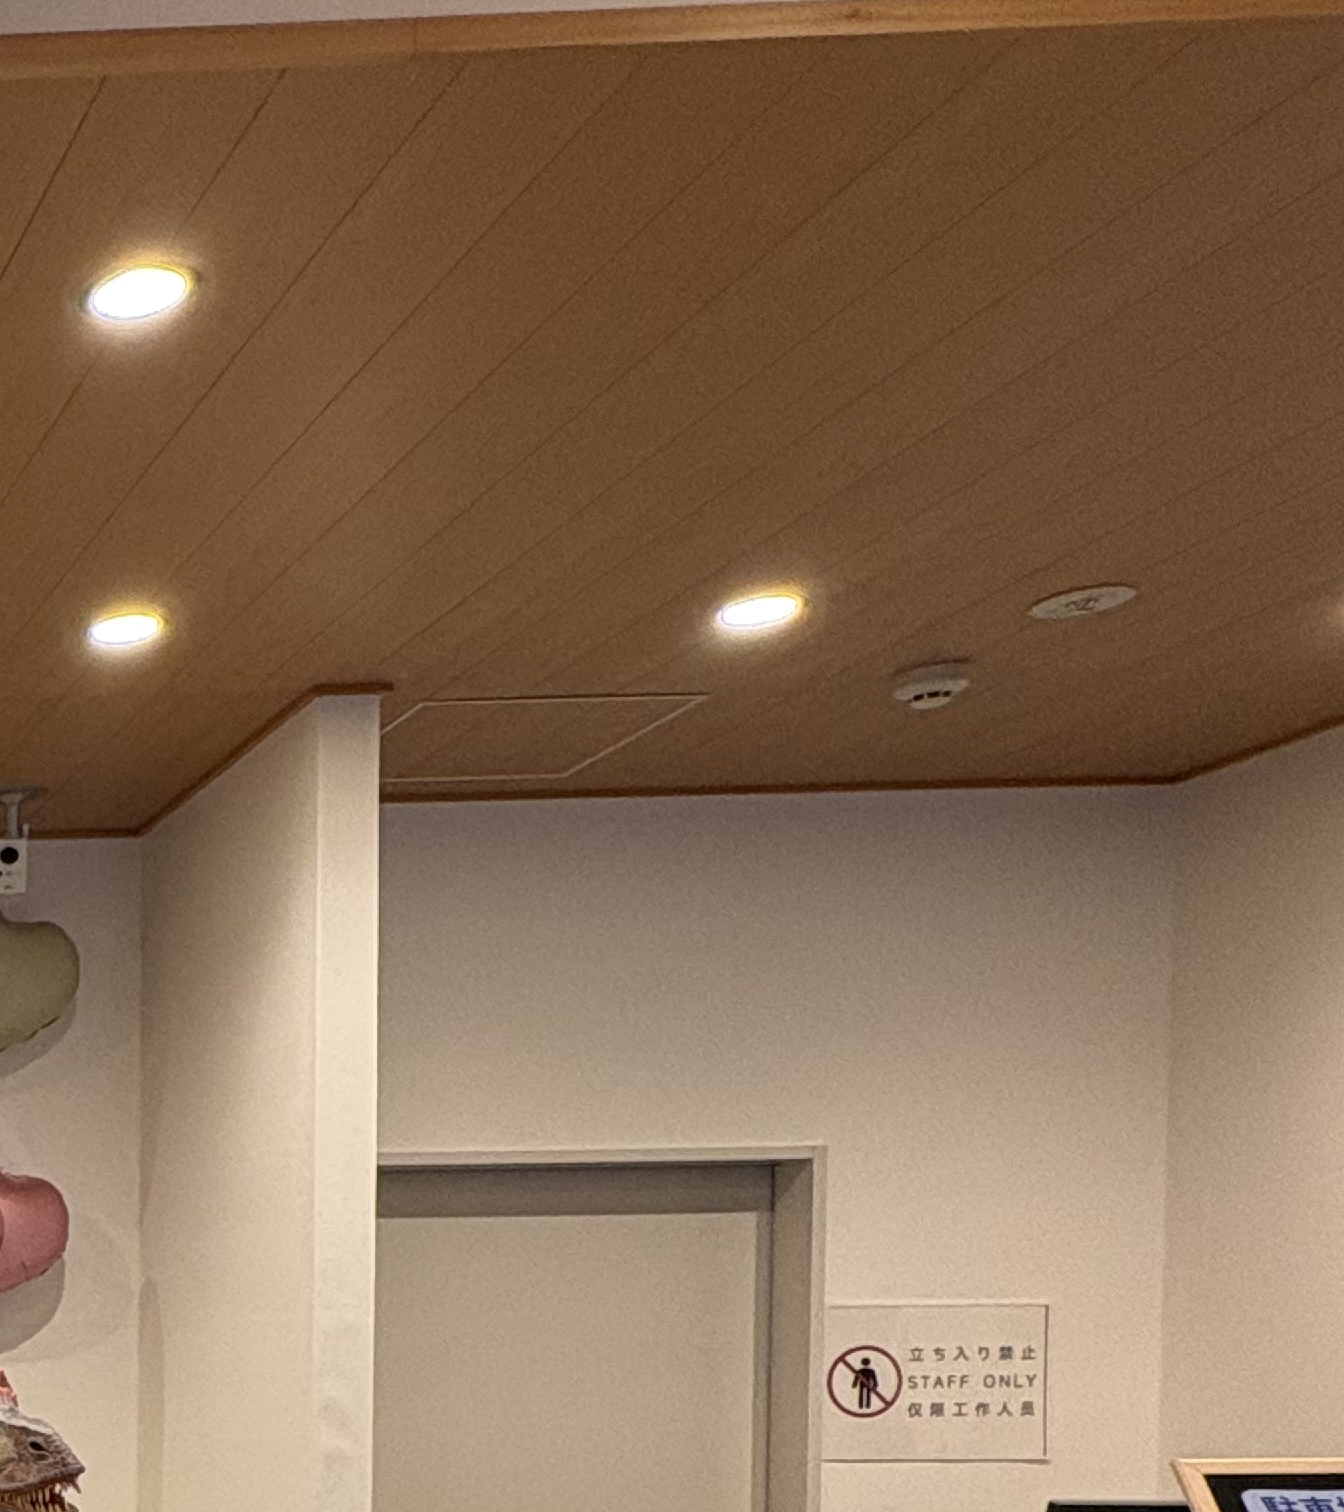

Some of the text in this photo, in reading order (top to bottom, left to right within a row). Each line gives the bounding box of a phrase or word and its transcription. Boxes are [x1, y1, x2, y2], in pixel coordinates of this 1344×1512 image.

[908, 1345, 1037, 1362] 立ち入り禁止
[907, 1373, 1038, 1390] STAFF ONLY
